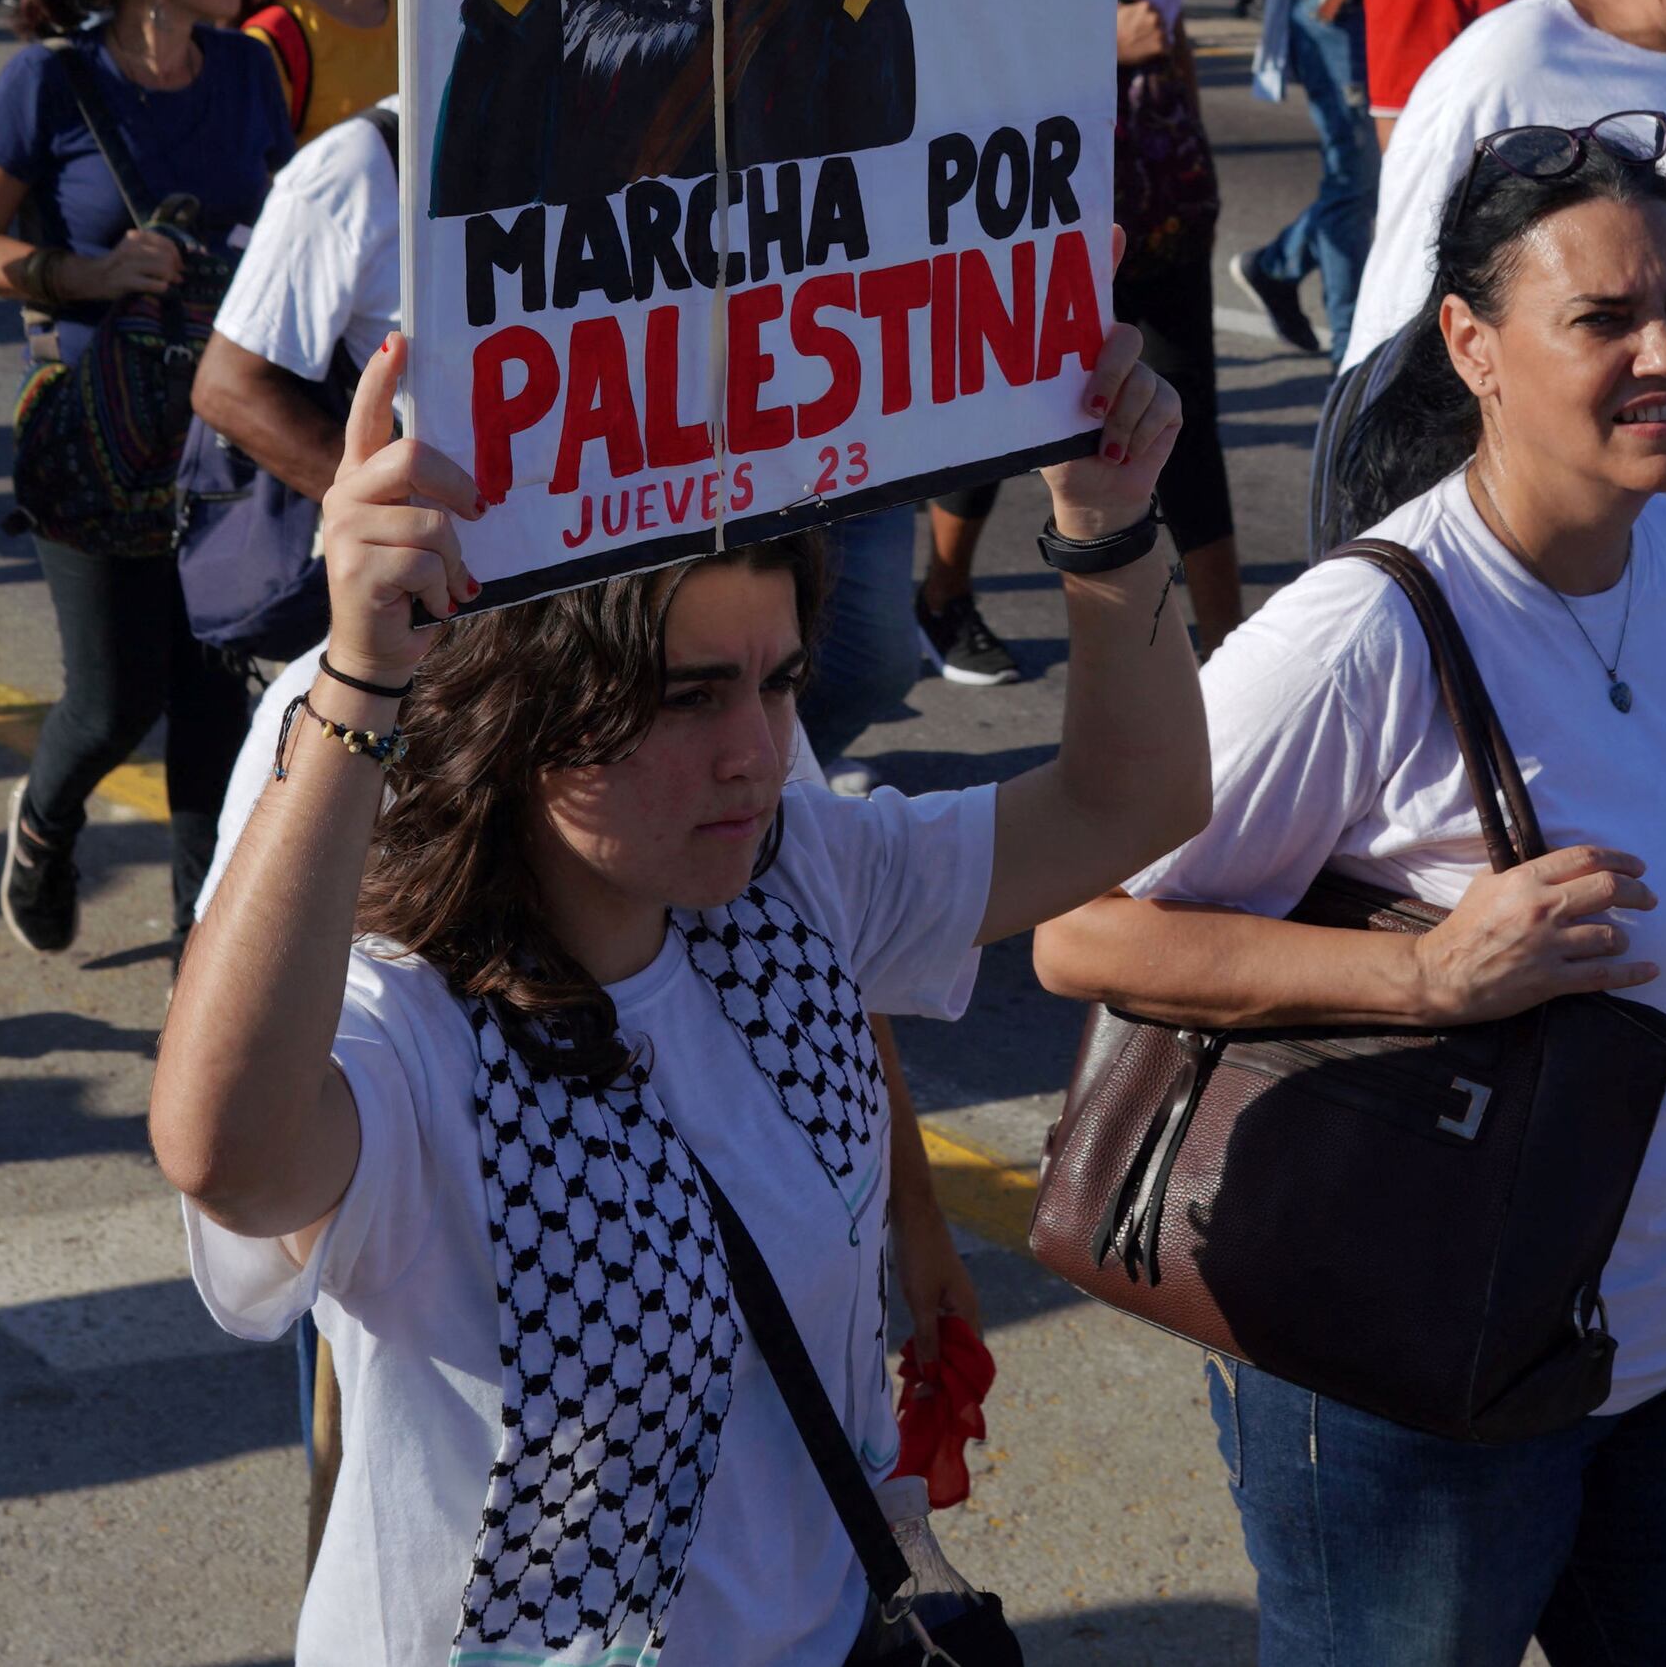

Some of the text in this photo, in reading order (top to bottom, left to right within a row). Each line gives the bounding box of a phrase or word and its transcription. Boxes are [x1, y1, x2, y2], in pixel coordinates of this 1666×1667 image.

[466, 115, 1081, 326] MARCHA POR
[472, 230, 1104, 505] PALESTINA
[562, 442, 869, 549] JUEVES 23
